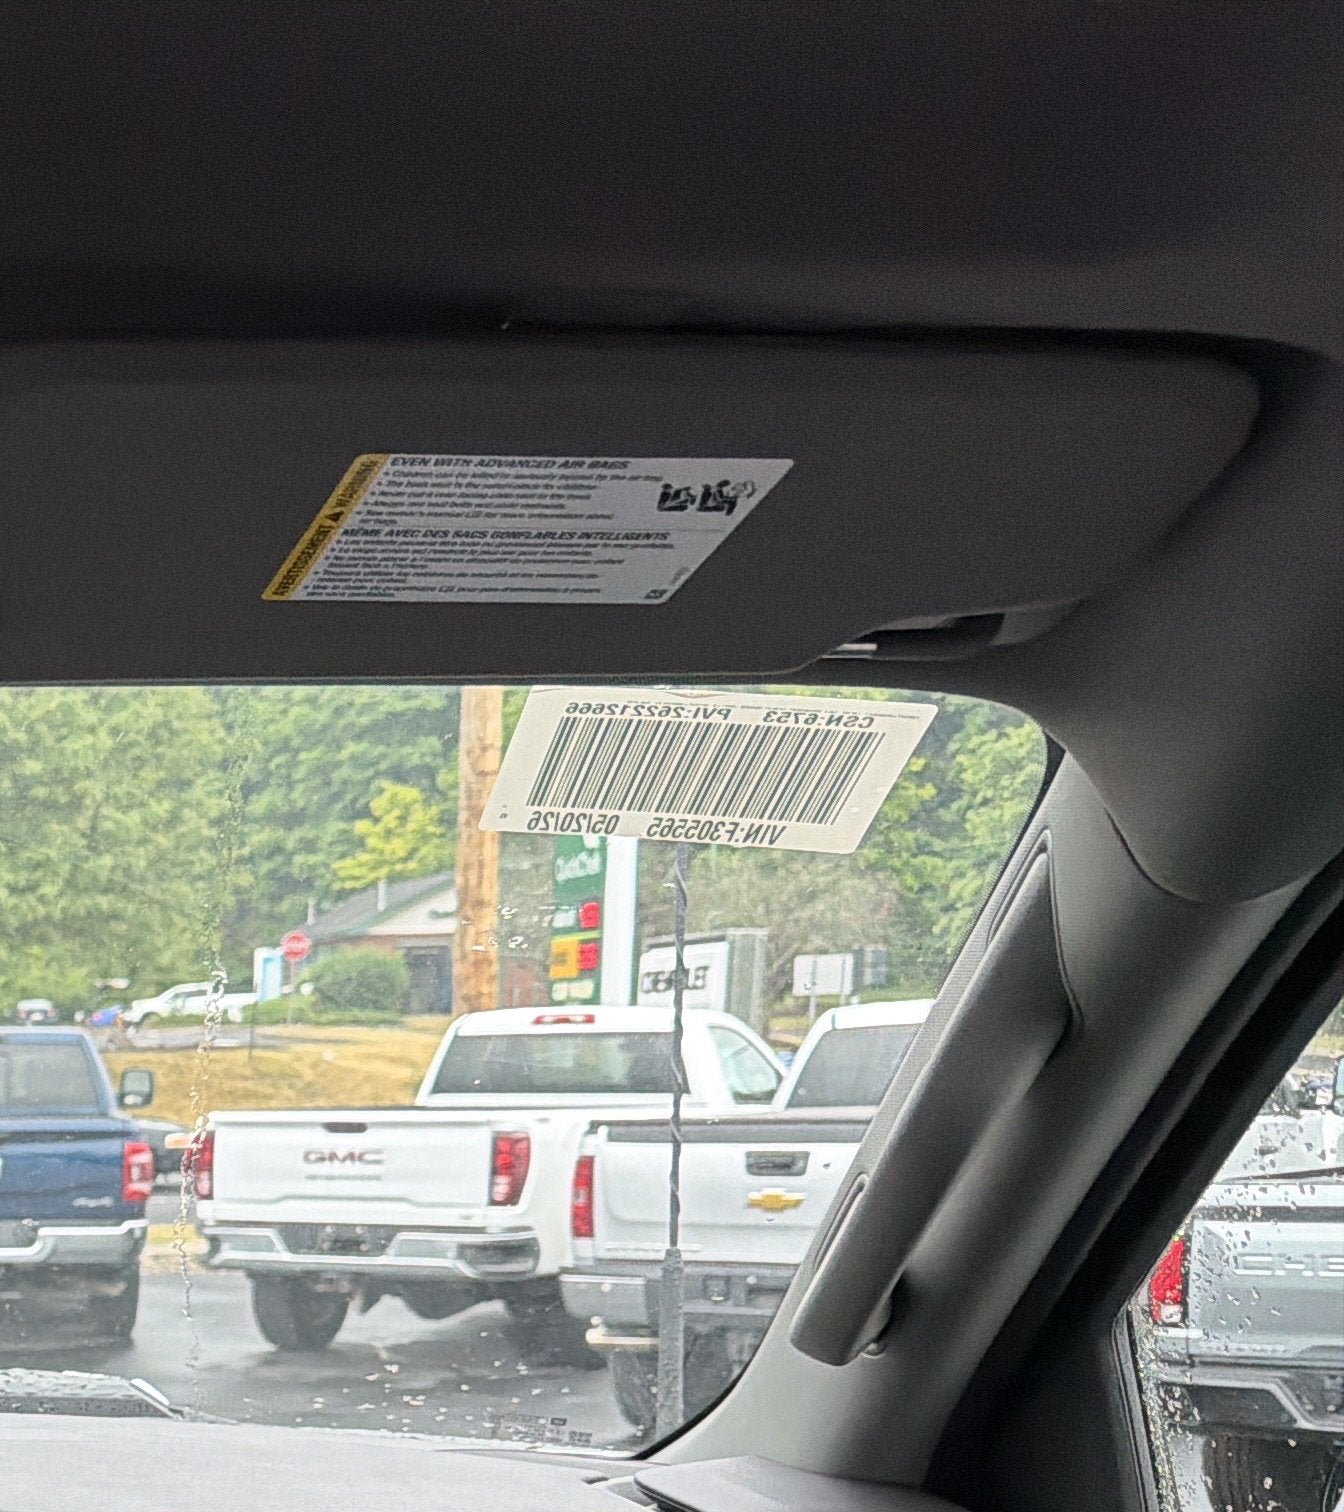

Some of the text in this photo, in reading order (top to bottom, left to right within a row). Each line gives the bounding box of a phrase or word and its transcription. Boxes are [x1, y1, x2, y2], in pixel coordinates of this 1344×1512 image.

[390, 457, 431, 467] EVEN
[433, 458, 473, 468] WITH
[474, 459, 557, 469] ADVANCED
[558, 460, 586, 469] AIR
[385, 529, 421, 537] AVEC
[422, 529, 450, 538] DES
[452, 530, 488, 539] SACS
[303, 1150, 385, 1165] GMC
